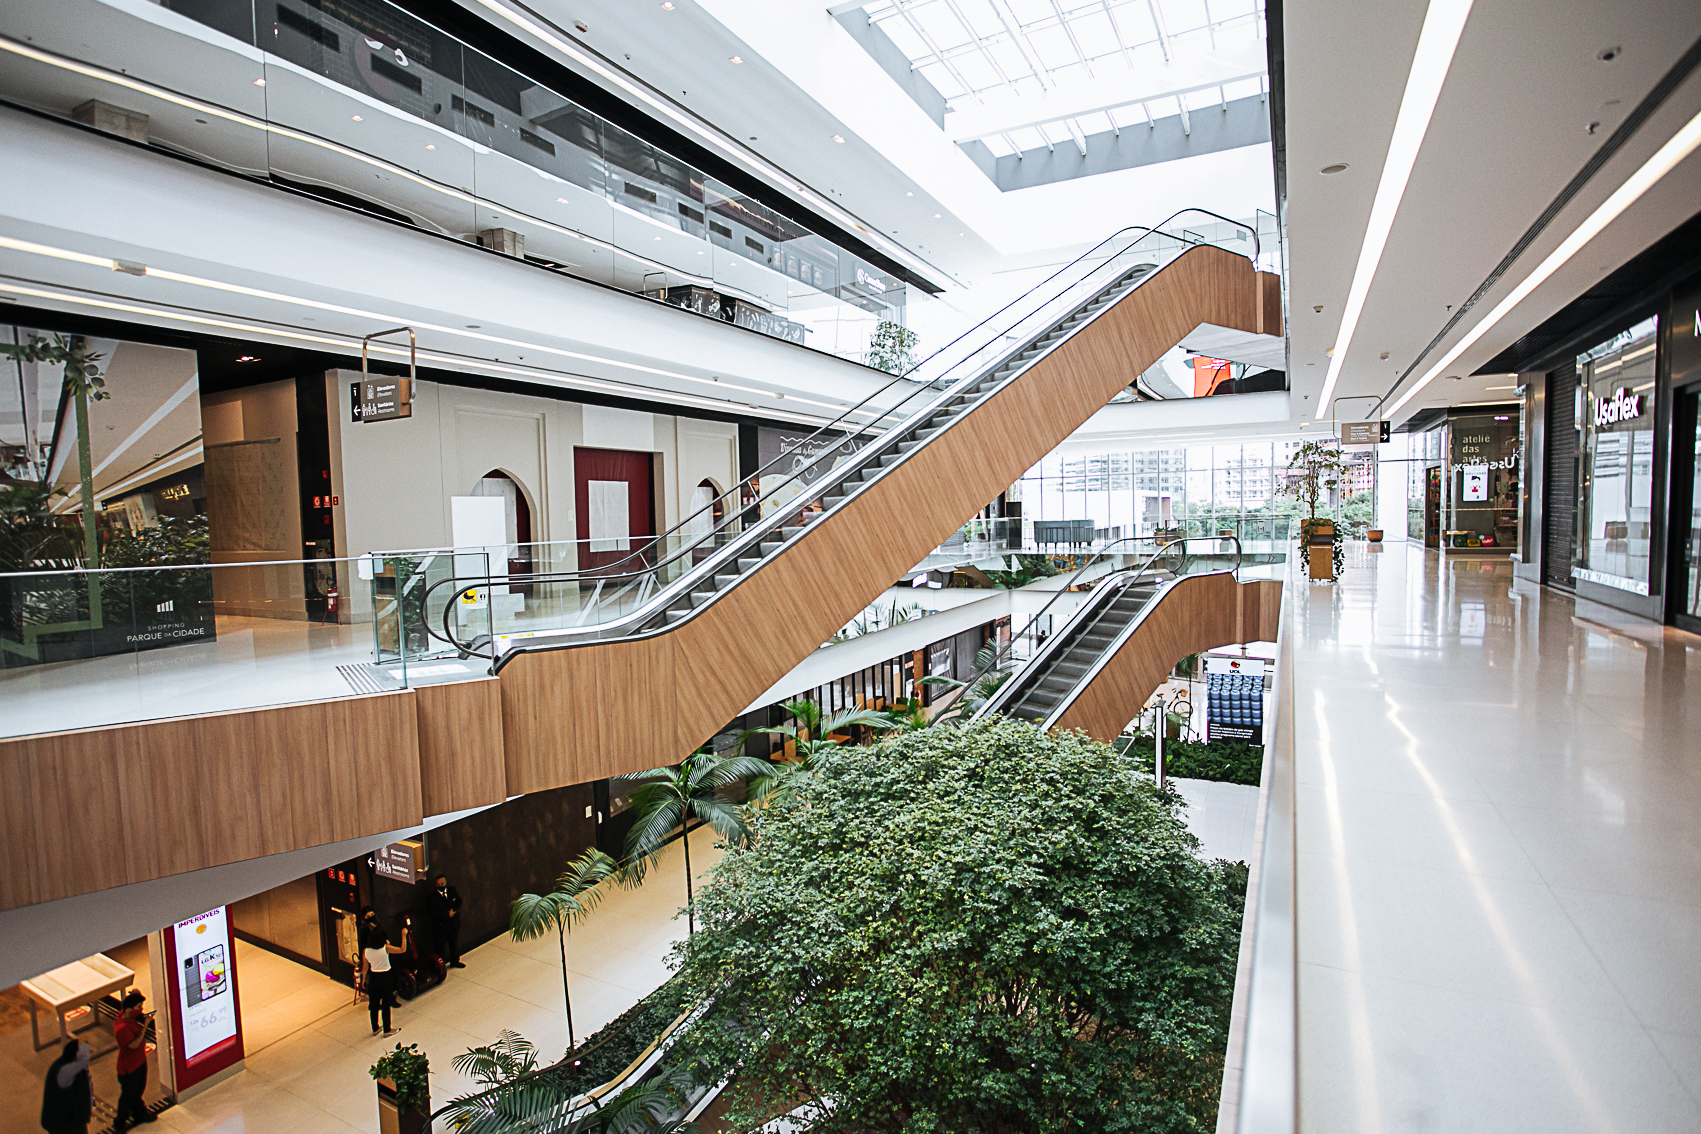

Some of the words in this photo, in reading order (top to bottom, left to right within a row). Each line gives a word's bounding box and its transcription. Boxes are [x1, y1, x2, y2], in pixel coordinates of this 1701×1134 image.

[1594, 386, 1640, 427] Usaflex
[1462, 445, 1480, 453] das
[147, 622, 185, 631] SHOPPING
[127, 633, 163, 642] PARQUE
[172, 627, 205, 638] CIDADE
[390, 848, 410, 858] Elevadores
[391, 864, 409, 873] Sanitários
[201, 957, 210, 965] LG
